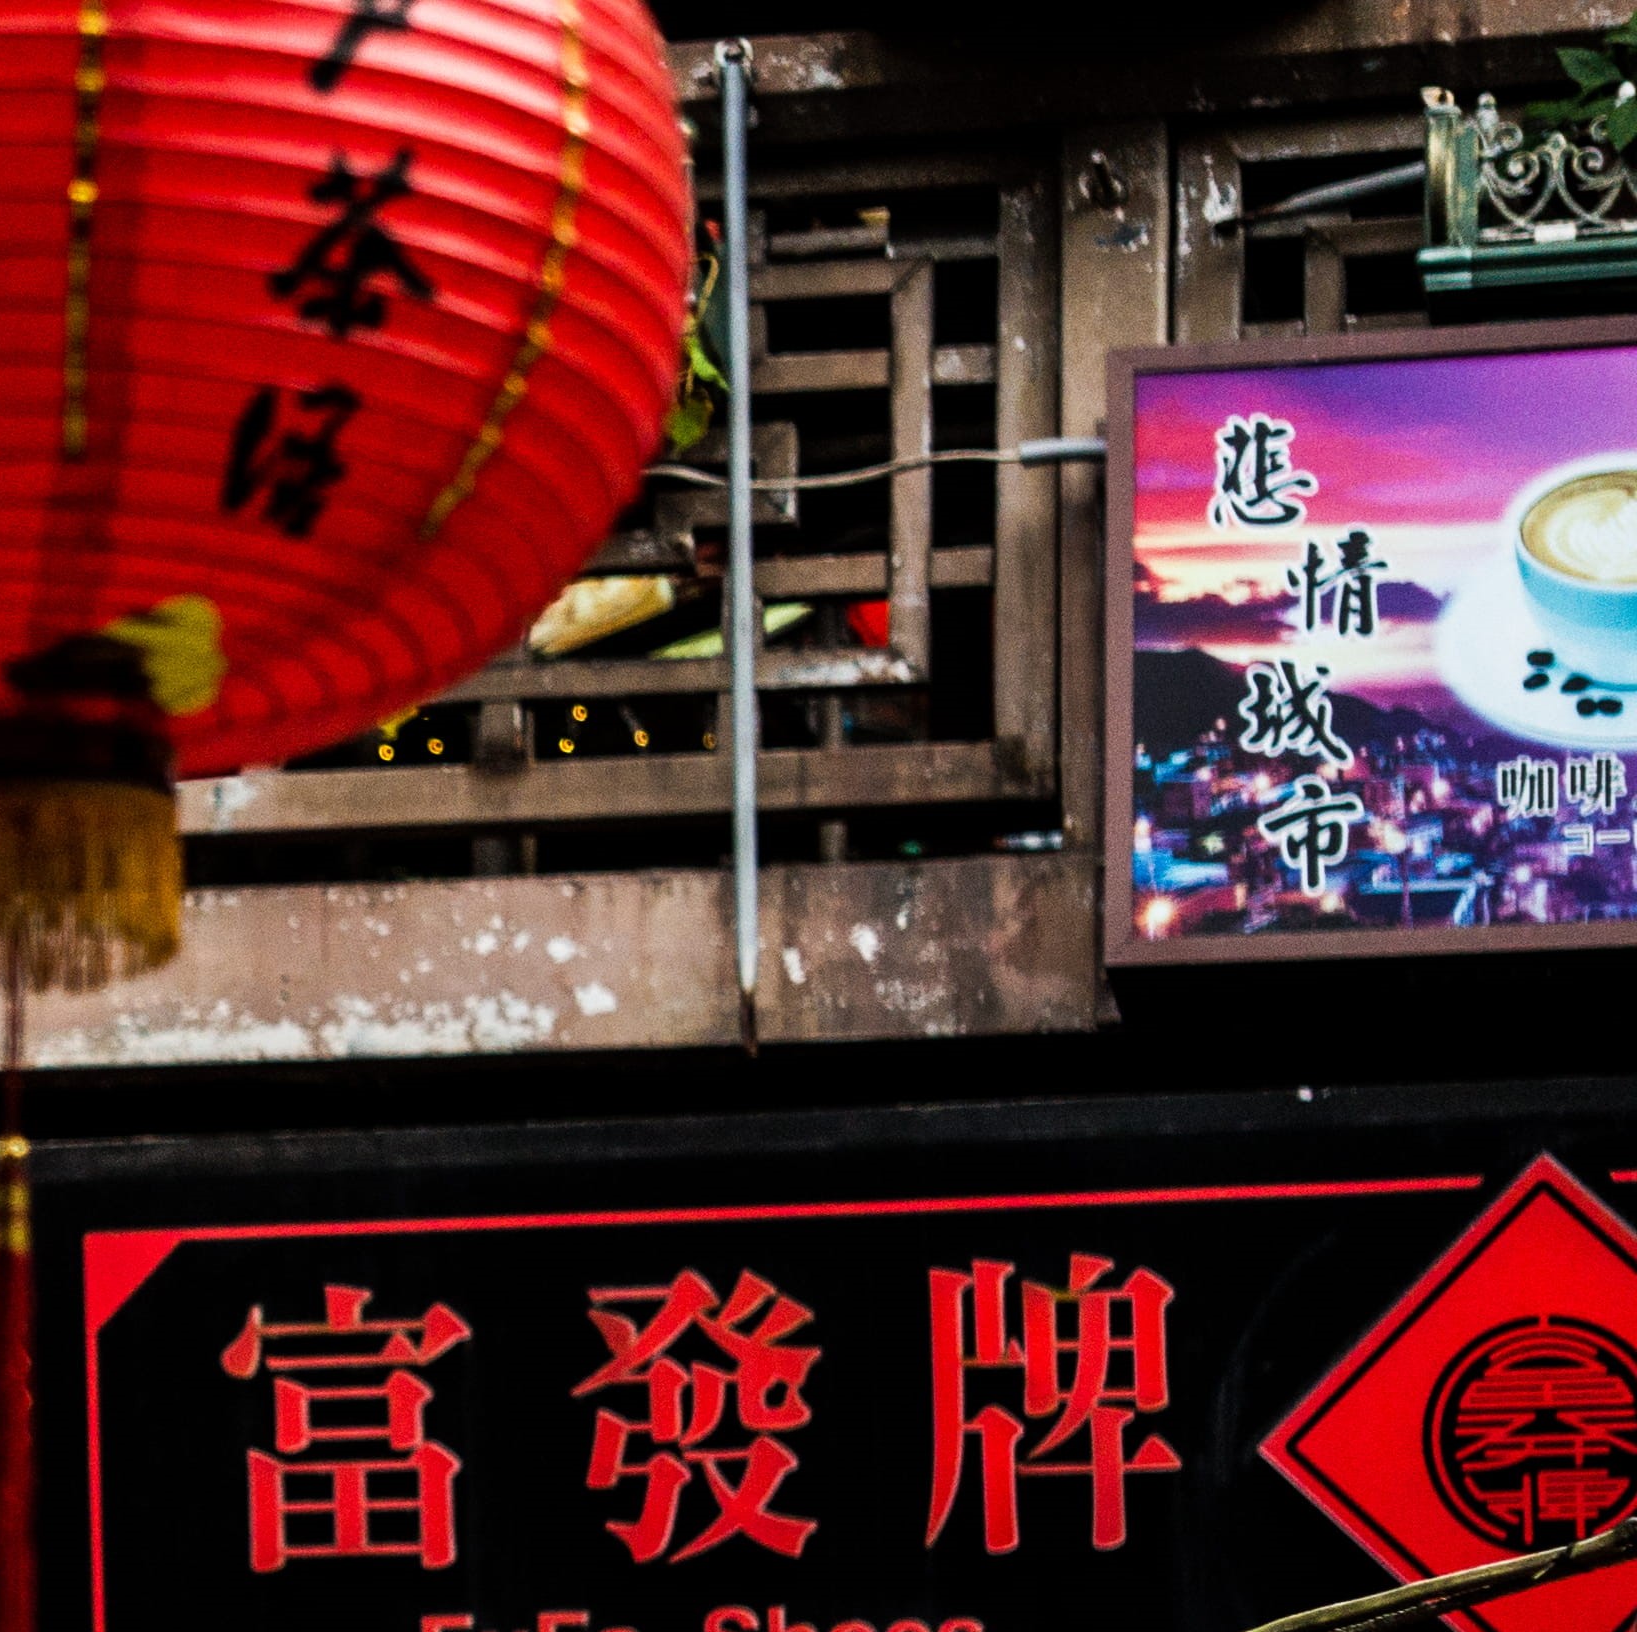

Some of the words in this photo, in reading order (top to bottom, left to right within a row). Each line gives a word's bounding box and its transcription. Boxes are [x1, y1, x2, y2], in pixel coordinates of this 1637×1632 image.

[1211, 413, 1386, 893] 悲情城市
[1498, 753, 1626, 819] 咖啡
[223, 1253, 1182, 1574] 富發牌
